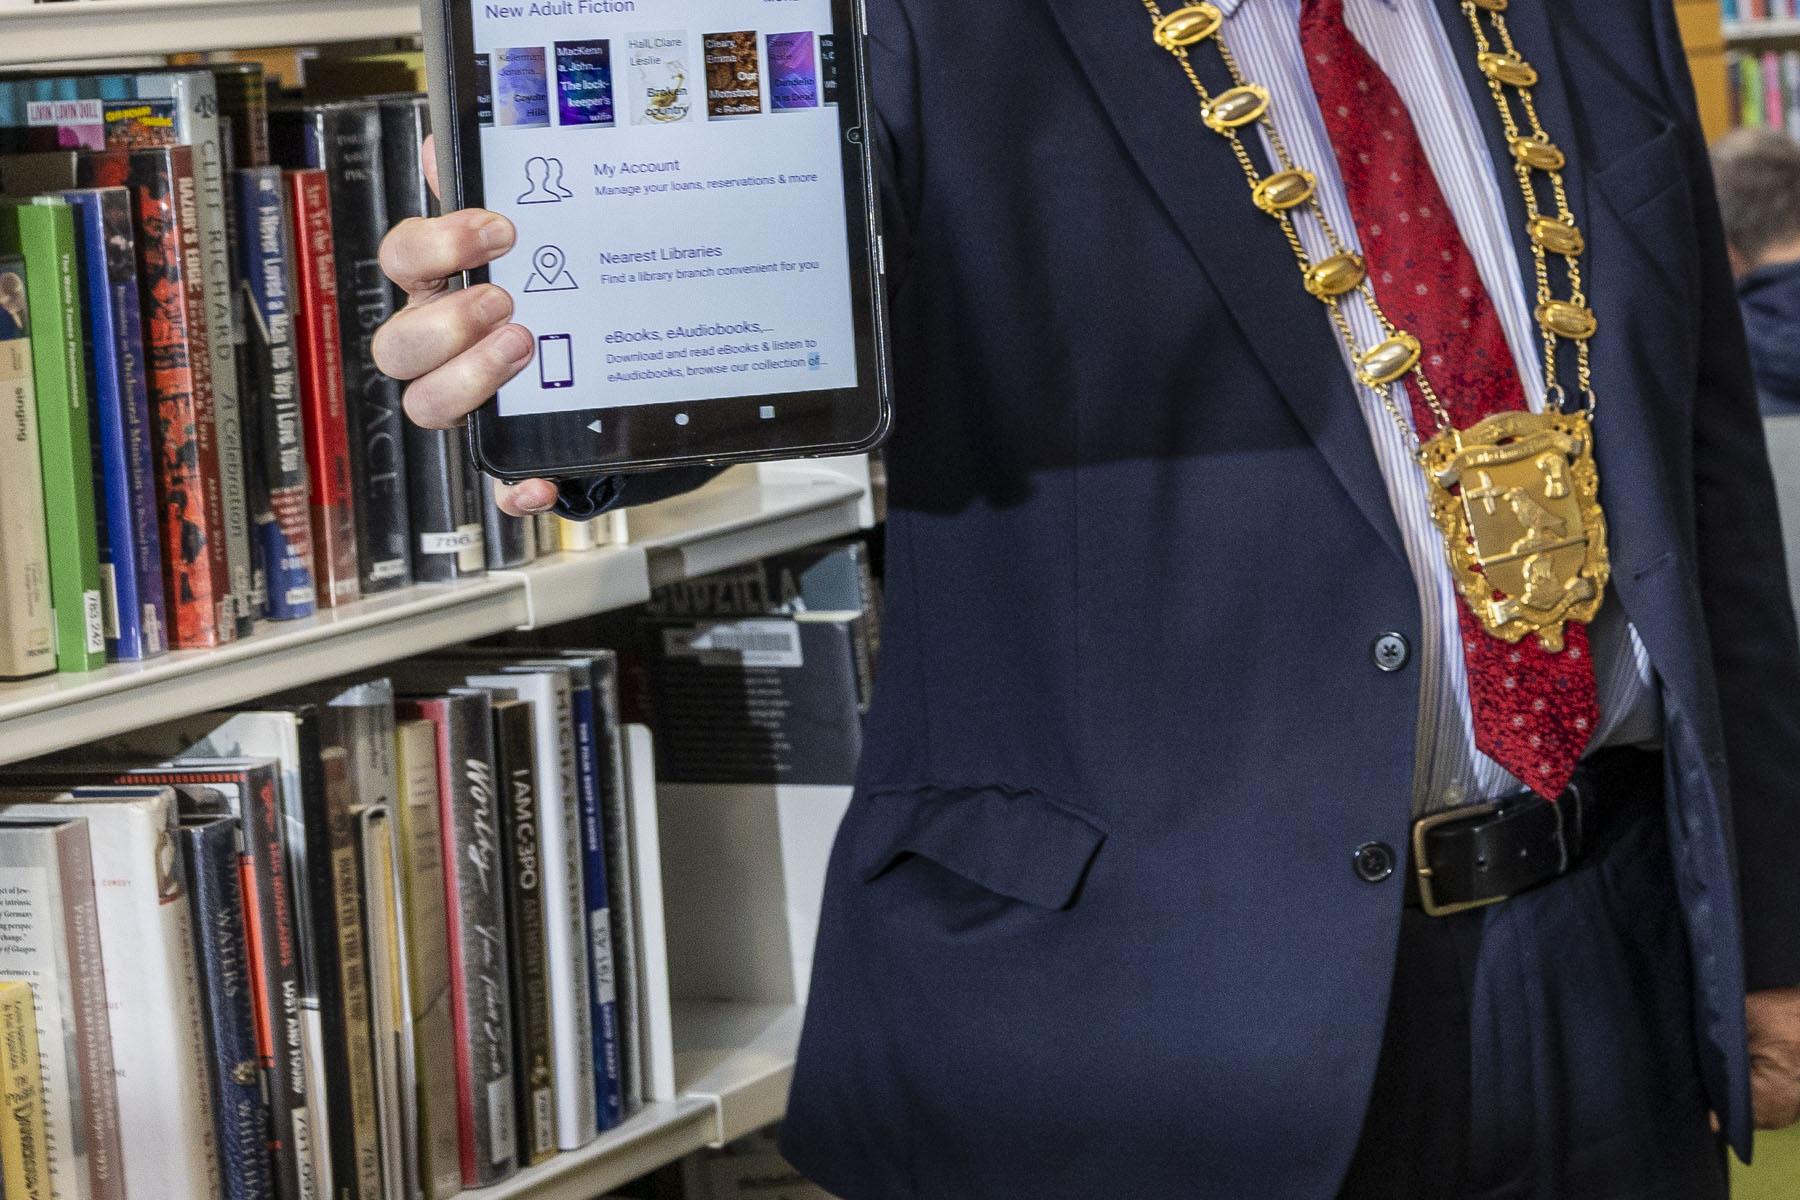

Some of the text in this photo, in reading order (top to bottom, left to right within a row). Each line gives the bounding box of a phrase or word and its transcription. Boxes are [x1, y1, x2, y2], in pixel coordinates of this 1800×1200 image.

[486, 0, 635, 19] New Adult Fiction
[557, 46, 603, 56] MacKenn
[628, 38, 682, 49] Hall, Clare
[630, 56, 661, 66] Leslie
[560, 80, 610, 91] The lock-
[647, 87, 688, 98] Broken
[568, 98, 611, 108] keeper's
[646, 106, 689, 117] country
[594, 160, 680, 178] My Account
[595, 173, 818, 196] Manage your loans, reservations & more
[177, 177, 201, 248] RAZOR'S
[61, 253, 71, 273] The
[600, 245, 722, 265] Nearest Libraries
[264, 258, 285, 297] Loved
[601, 260, 819, 284] Find a library branch convenient for you
[267, 300, 284, 311] a
[269, 313, 290, 344] Man
[605, 328, 662, 343] eBooks,
[272, 346, 292, 369] the
[606, 339, 817, 364] Download and read eBooks & listen to
[607, 357, 806, 382] eAudiobooks, browse our collection
[206, 230, 234, 363] RICHARD
[222, 418, 245, 539] Celebration
[269, 371, 295, 399] Way
[12, 387, 30, 442] singing
[280, 412, 298, 445] Love
[281, 447, 300, 472] You
[513, 780, 534, 819] AM
[464, 758, 492, 894] Worthy
[11, 945, 37, 954] Glasgow
[286, 1017, 302, 1048] AND
